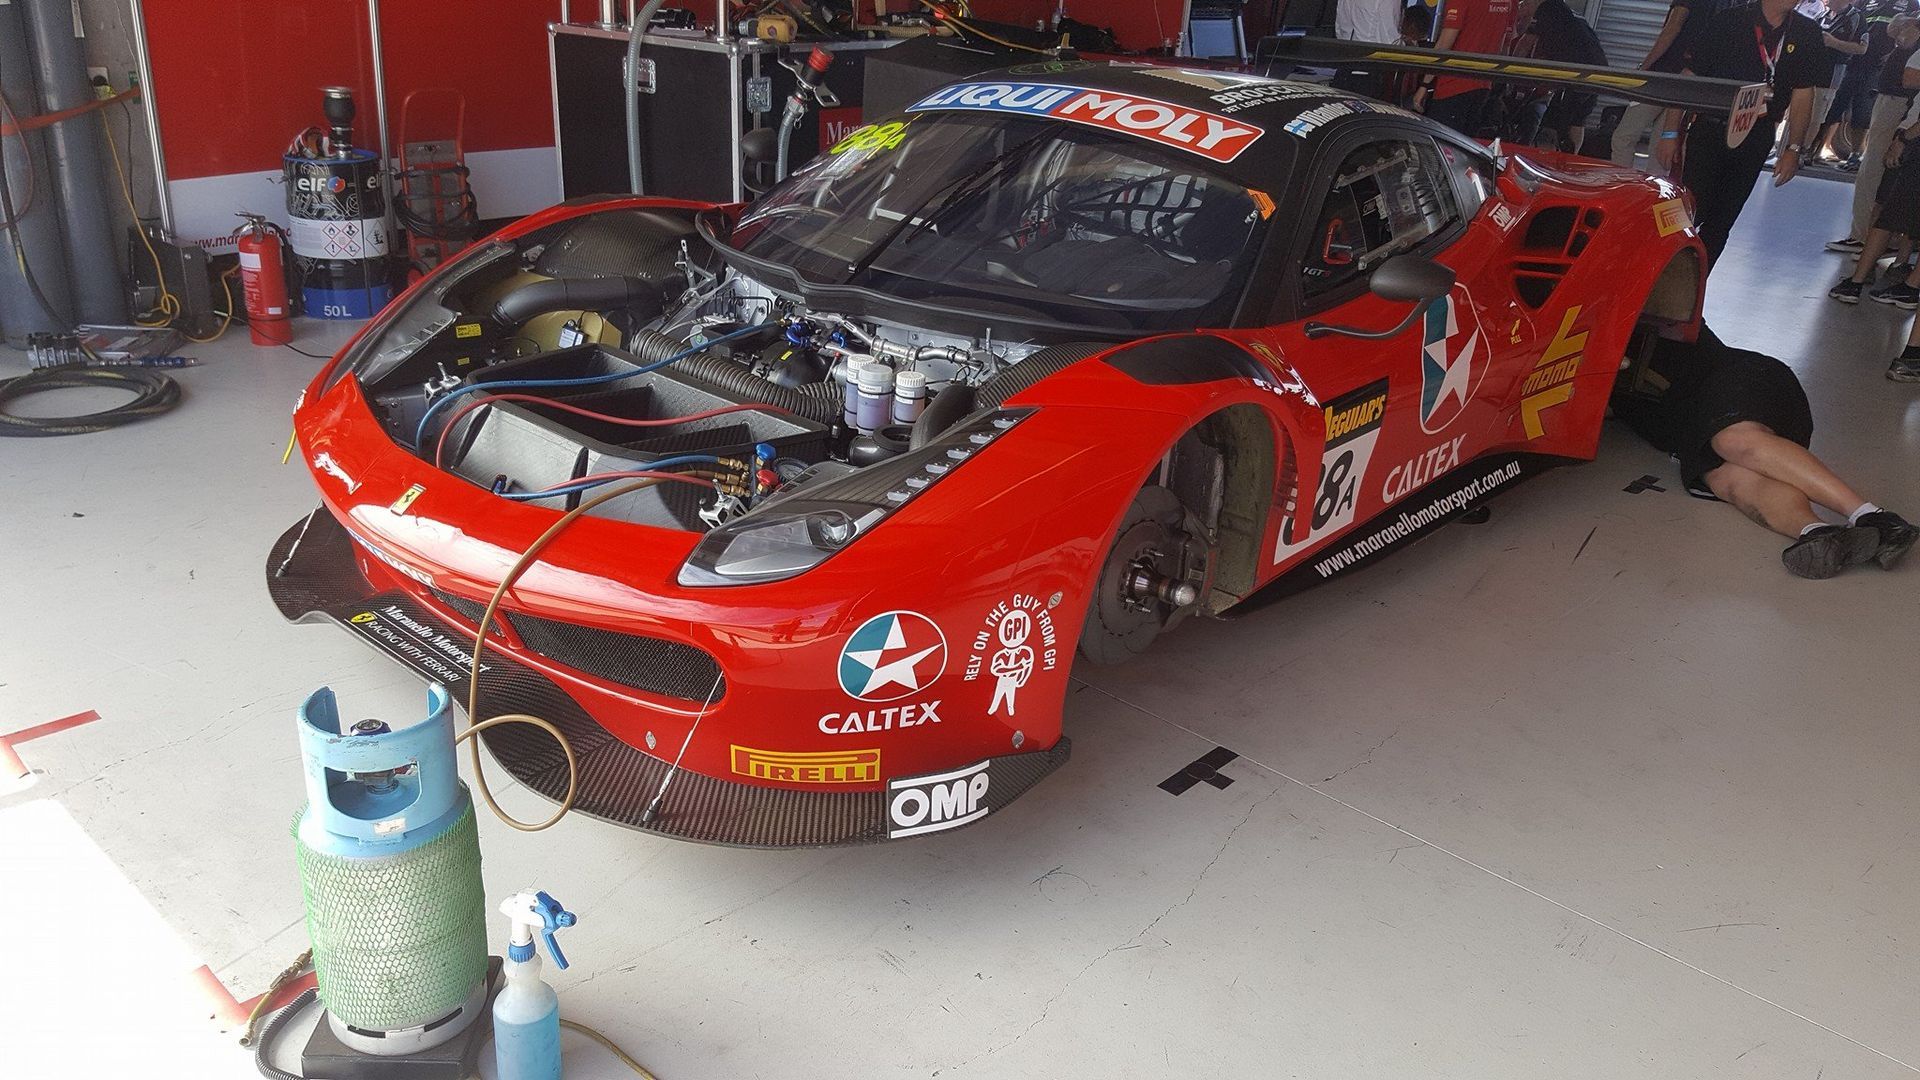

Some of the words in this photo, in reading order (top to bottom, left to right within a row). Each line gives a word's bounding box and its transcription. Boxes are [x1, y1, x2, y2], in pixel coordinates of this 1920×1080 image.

[918, 85, 1073, 110] LIQUI
[1060, 93, 1254, 150] MOLY
[298, 177, 327, 192] elf
[324, 305, 340, 317] 50
[1382, 433, 1467, 504] CALTEX
[1314, 459, 1521, 579] www.maranellomotorsport.com.au
[985, 601, 1009, 628] THE
[1013, 594, 1042, 612] GUY
[380, 605, 434, 639] Maranello
[432, 635, 492, 673] Motorspot
[973, 631, 991, 650] ON
[1004, 616, 1026, 642] GPI
[1036, 609, 1056, 647] FROM
[366, 620, 402, 644] RACING
[398, 640, 426, 660] WITH
[421, 656, 463, 682] FERRARI
[963, 654, 983, 681] RELY
[1043, 649, 1057, 670] GPI
[818, 700, 942, 735] CALTEX
[735, 746, 878, 781] PIRELLI
[890, 772, 990, 828] OMP
